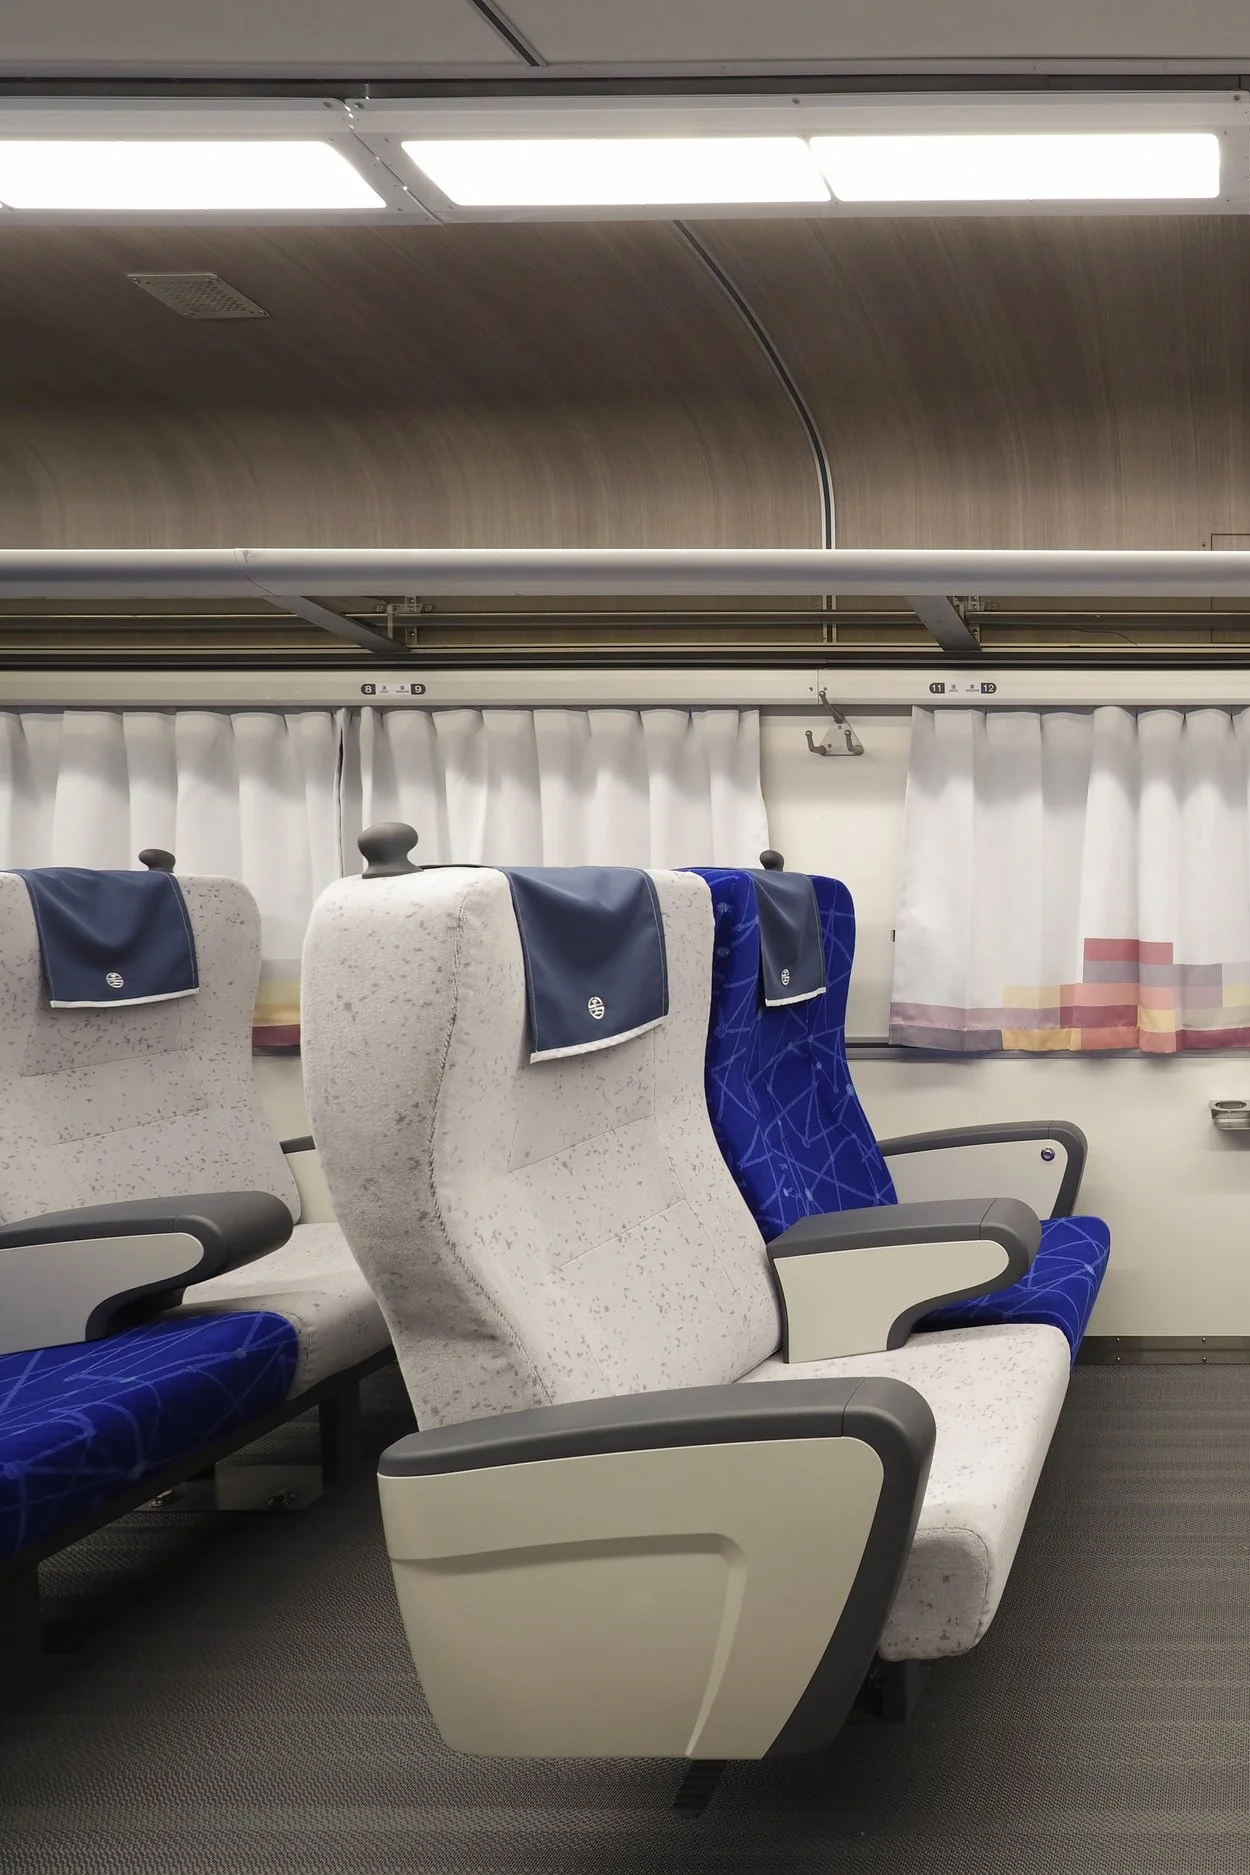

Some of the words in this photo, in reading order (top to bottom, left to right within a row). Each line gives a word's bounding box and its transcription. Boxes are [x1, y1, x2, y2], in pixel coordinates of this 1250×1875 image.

[364, 685, 373, 694] 8
[414, 685, 422, 694] 9
[931, 684, 942, 693] 11
[982, 684, 995, 693] 12
